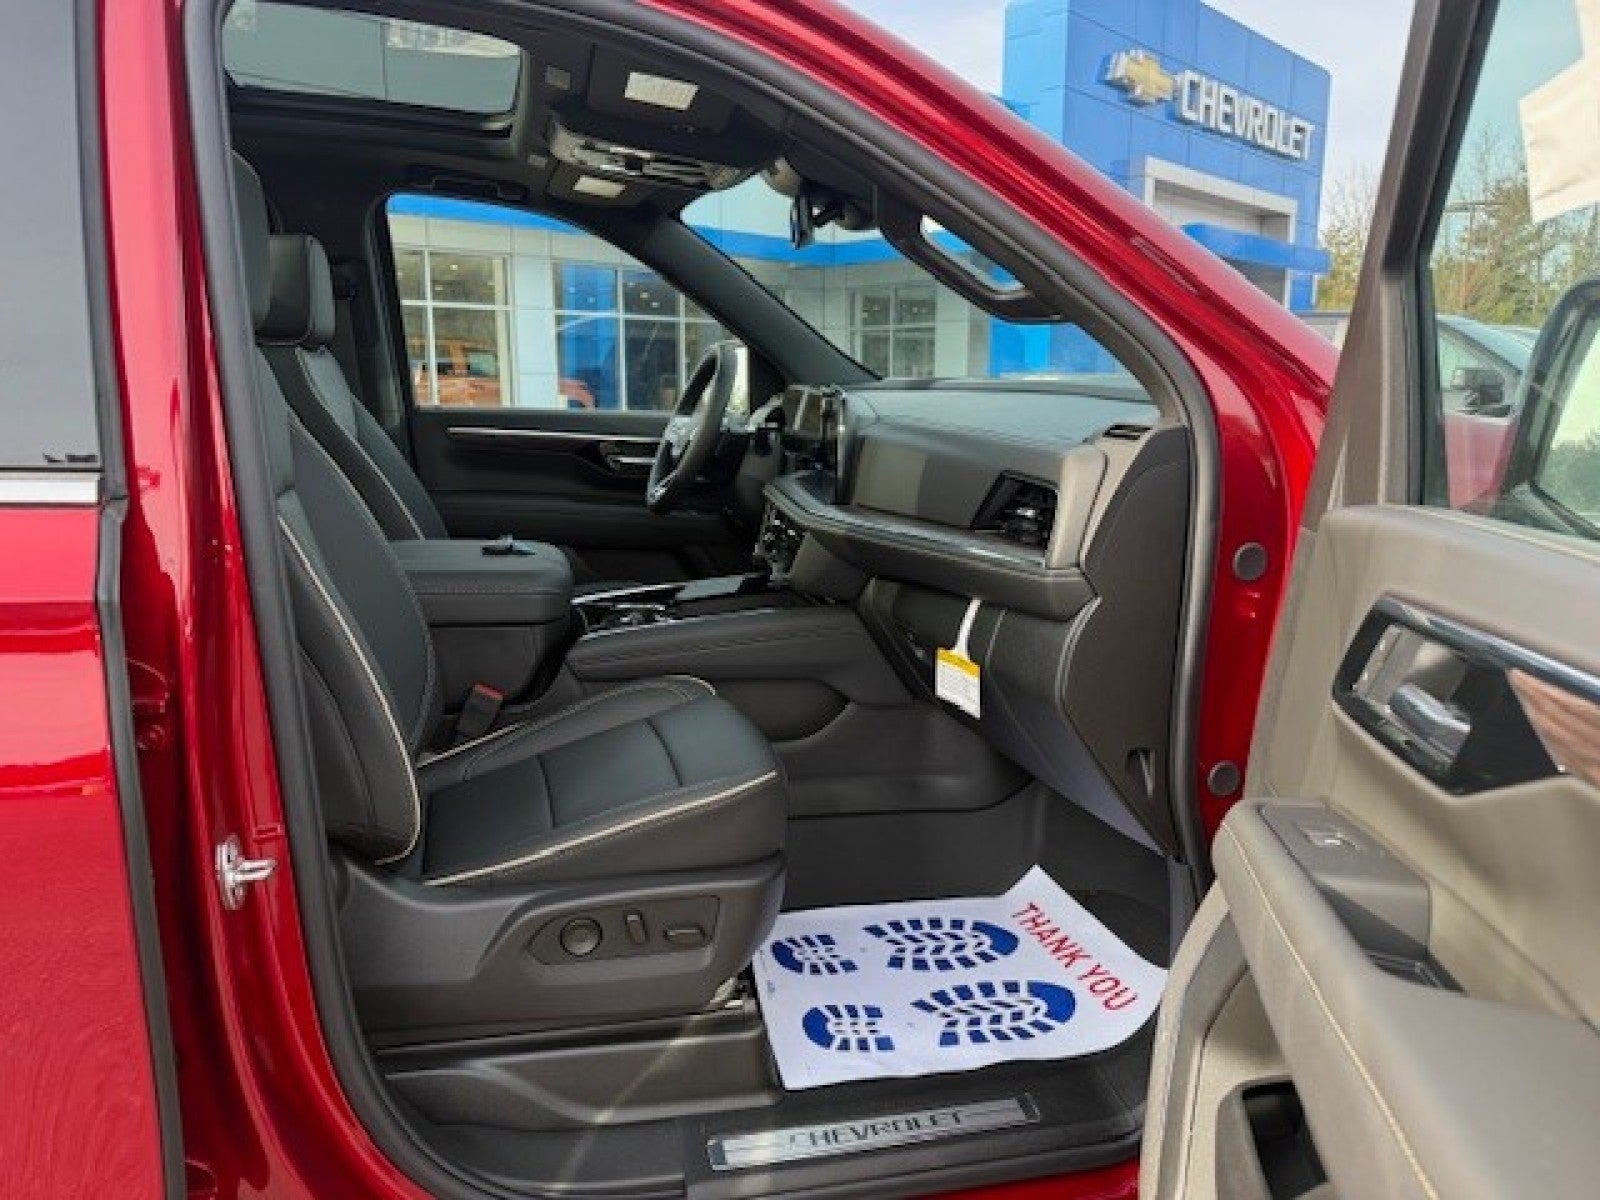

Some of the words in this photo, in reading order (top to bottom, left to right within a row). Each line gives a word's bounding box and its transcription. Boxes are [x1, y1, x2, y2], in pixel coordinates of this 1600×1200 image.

[1181, 69, 1315, 160] CHEVROLET
[1011, 902, 1092, 968] THANK
[1077, 963, 1138, 1010] YOU
[788, 1110, 962, 1149] CHEVROLET
